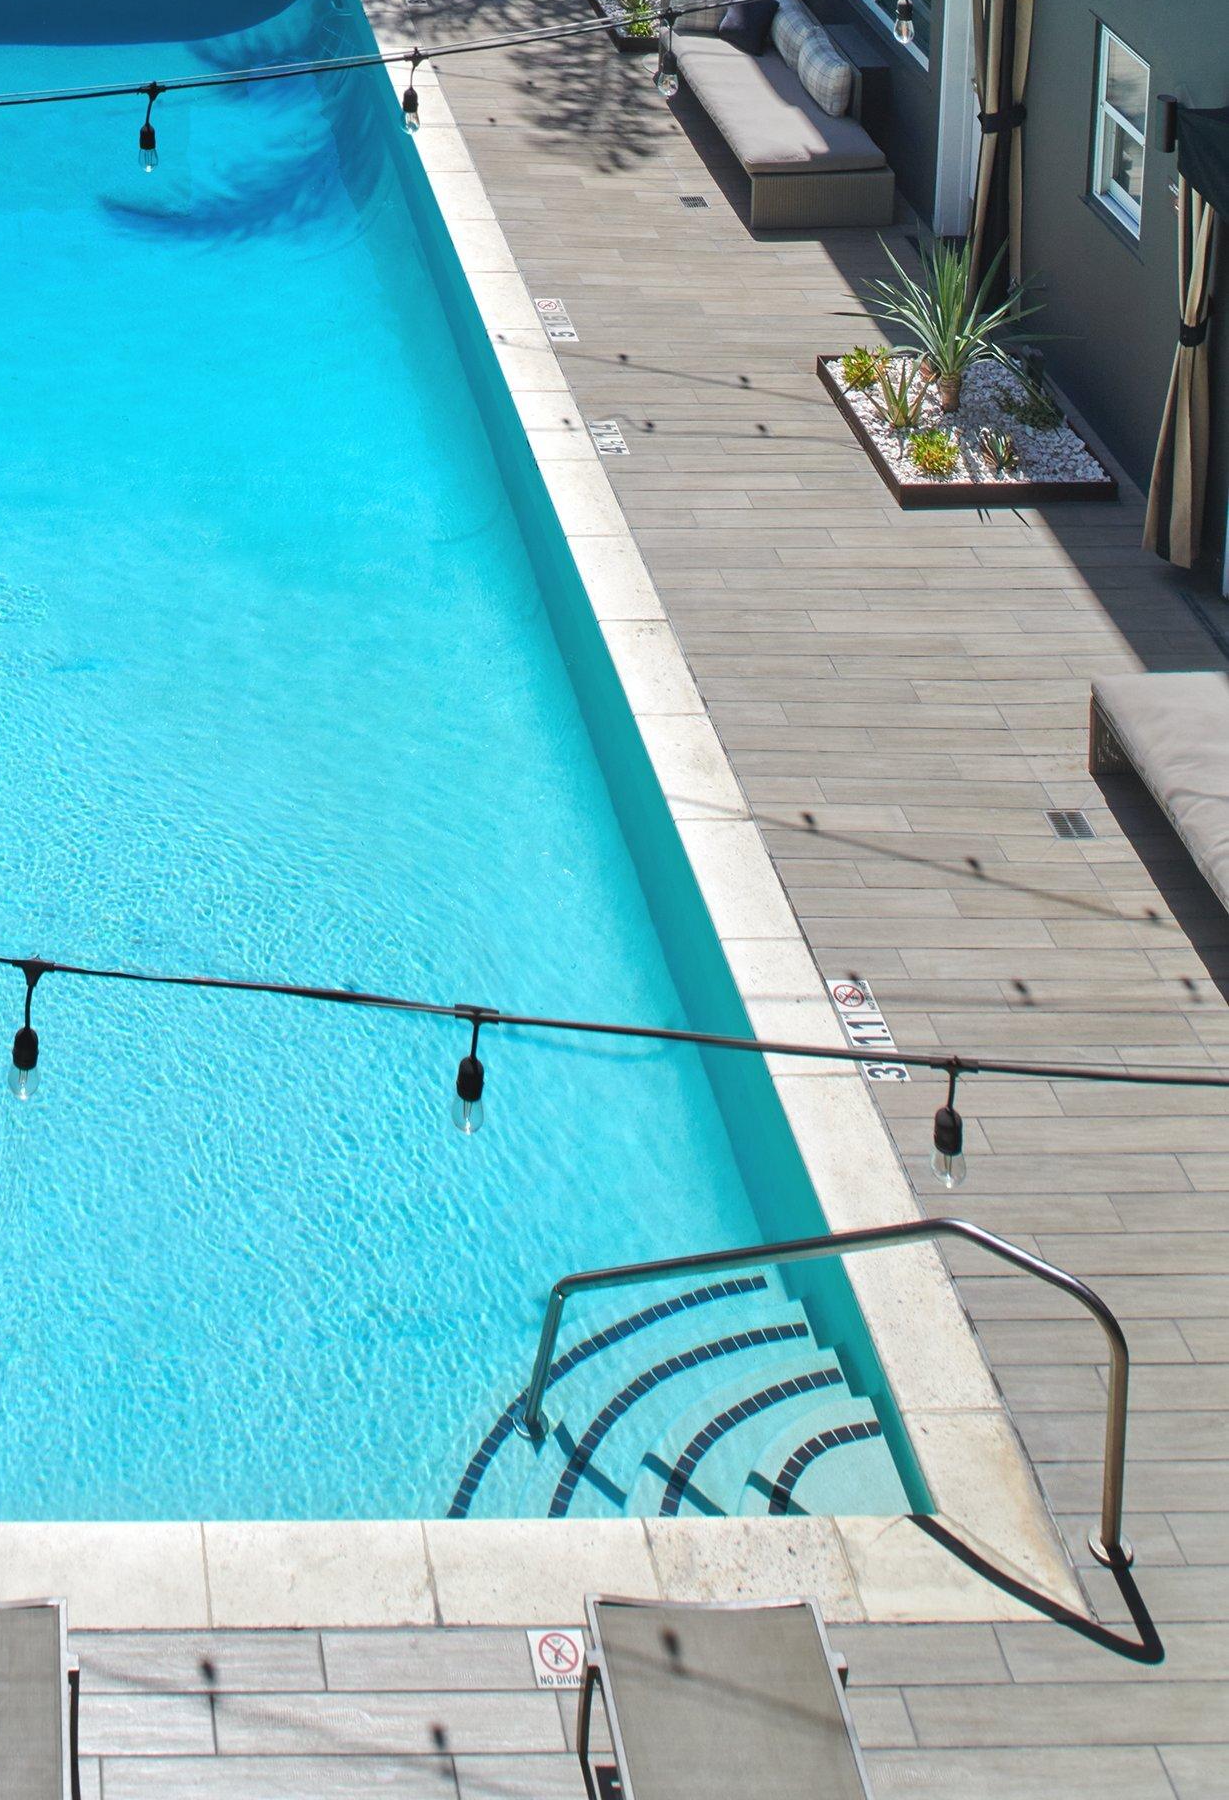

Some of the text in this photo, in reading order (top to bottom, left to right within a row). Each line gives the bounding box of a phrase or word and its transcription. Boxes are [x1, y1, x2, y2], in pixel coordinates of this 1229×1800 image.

[846, 1021, 891, 1045] 1.1
[540, 1675, 585, 1685] NO DIVIN
